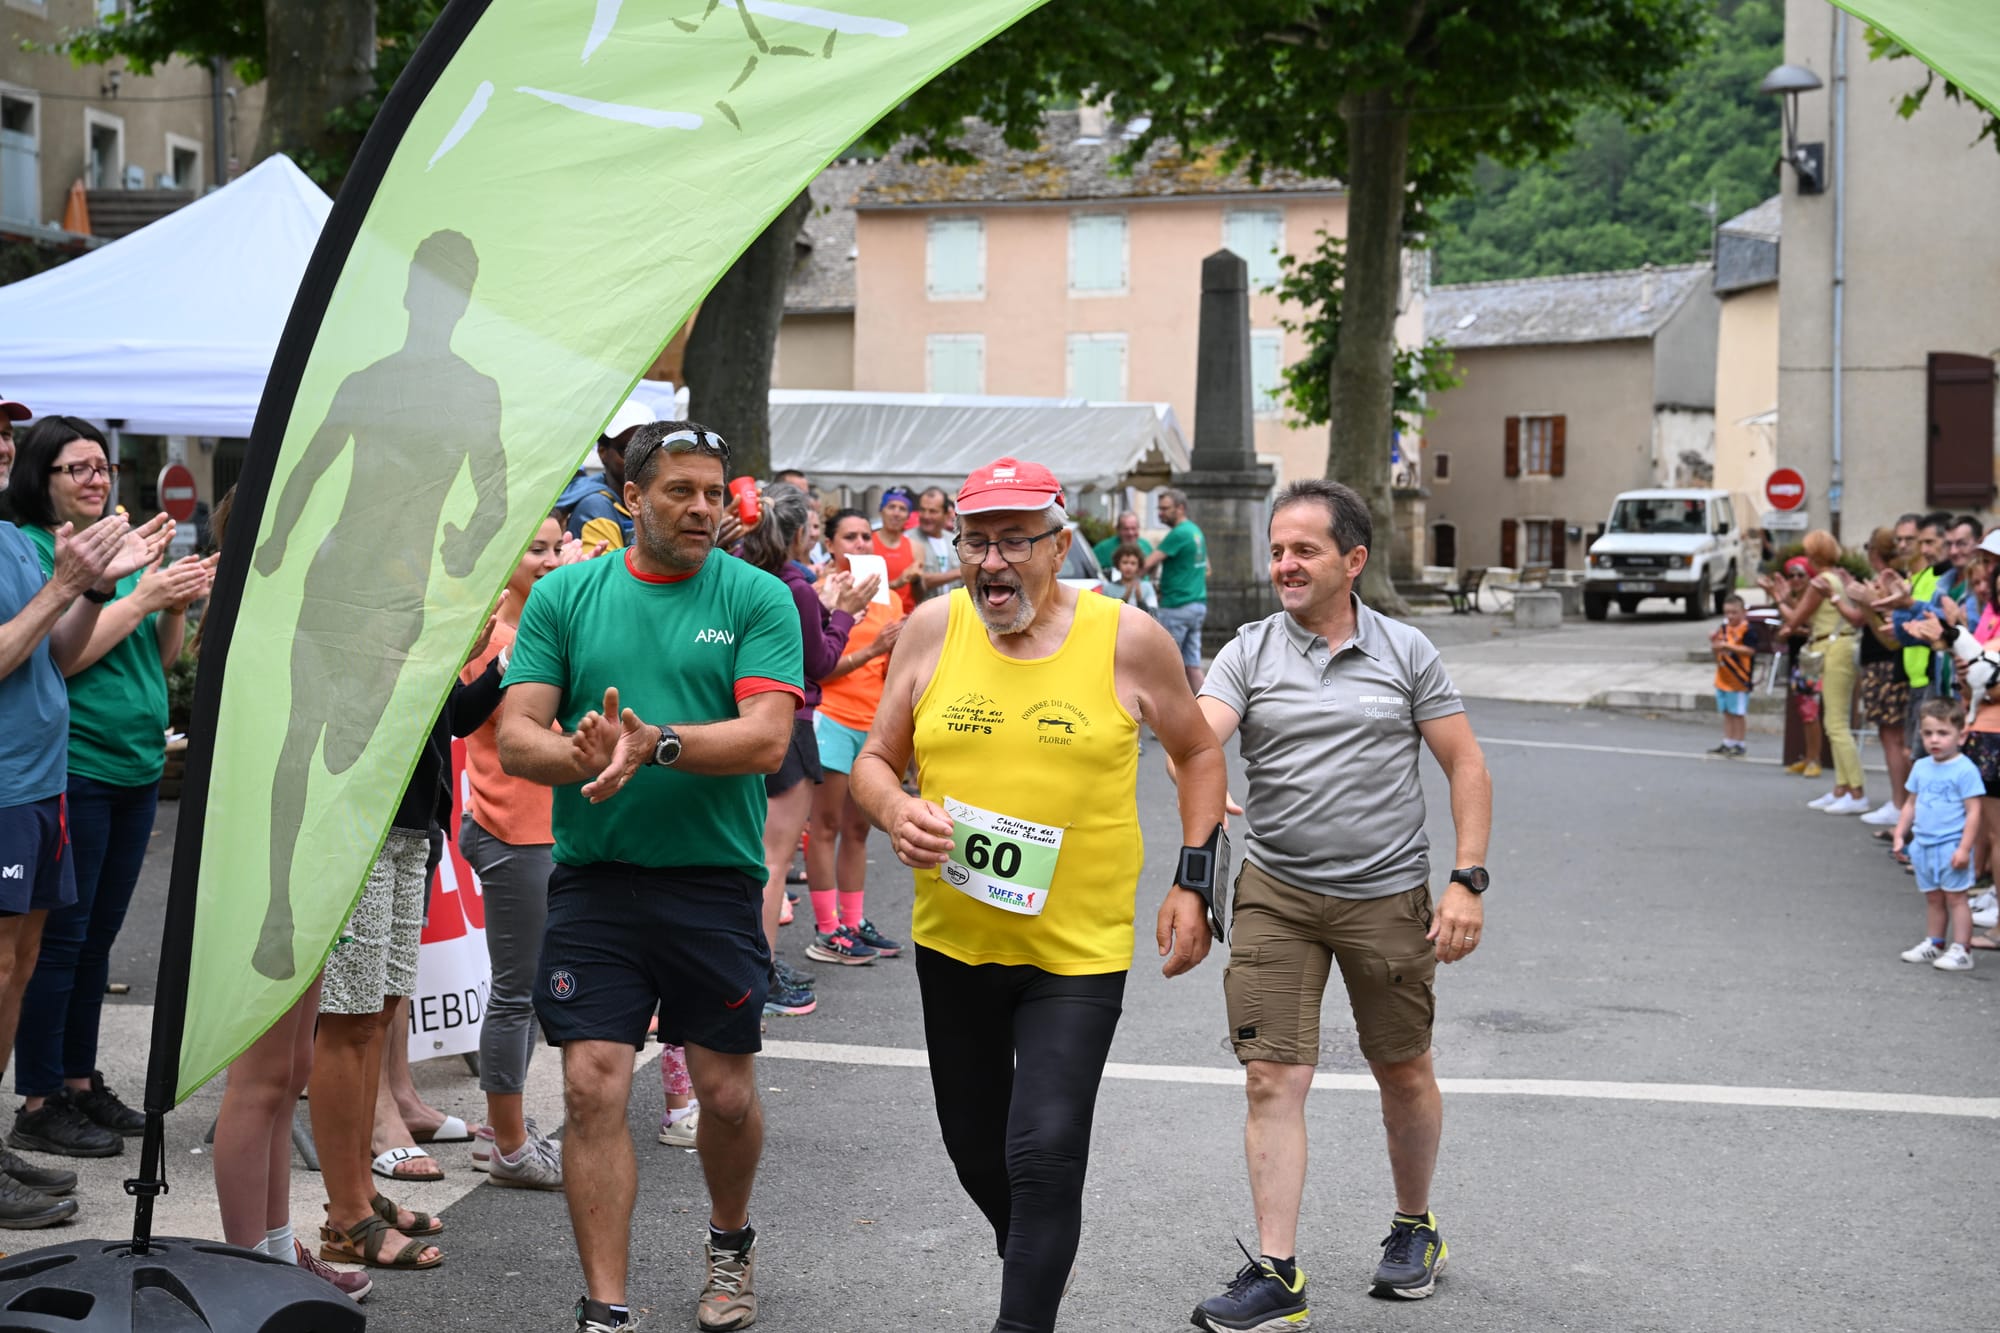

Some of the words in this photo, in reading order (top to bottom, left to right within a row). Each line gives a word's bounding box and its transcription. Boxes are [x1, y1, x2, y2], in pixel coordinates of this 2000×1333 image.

[1021, 699, 1049, 720] COURSE
[1051, 699, 1063, 707] DU
[947, 722, 992, 735] TUFF'S
[991, 824, 1019, 836] vallées
[996, 817, 1036, 833] Challenge
[1040, 828, 1054, 836] des
[965, 833, 1022, 878] 60
[987, 885, 1023, 901] TUFF'S
[989, 892, 1026, 908] Aventure
